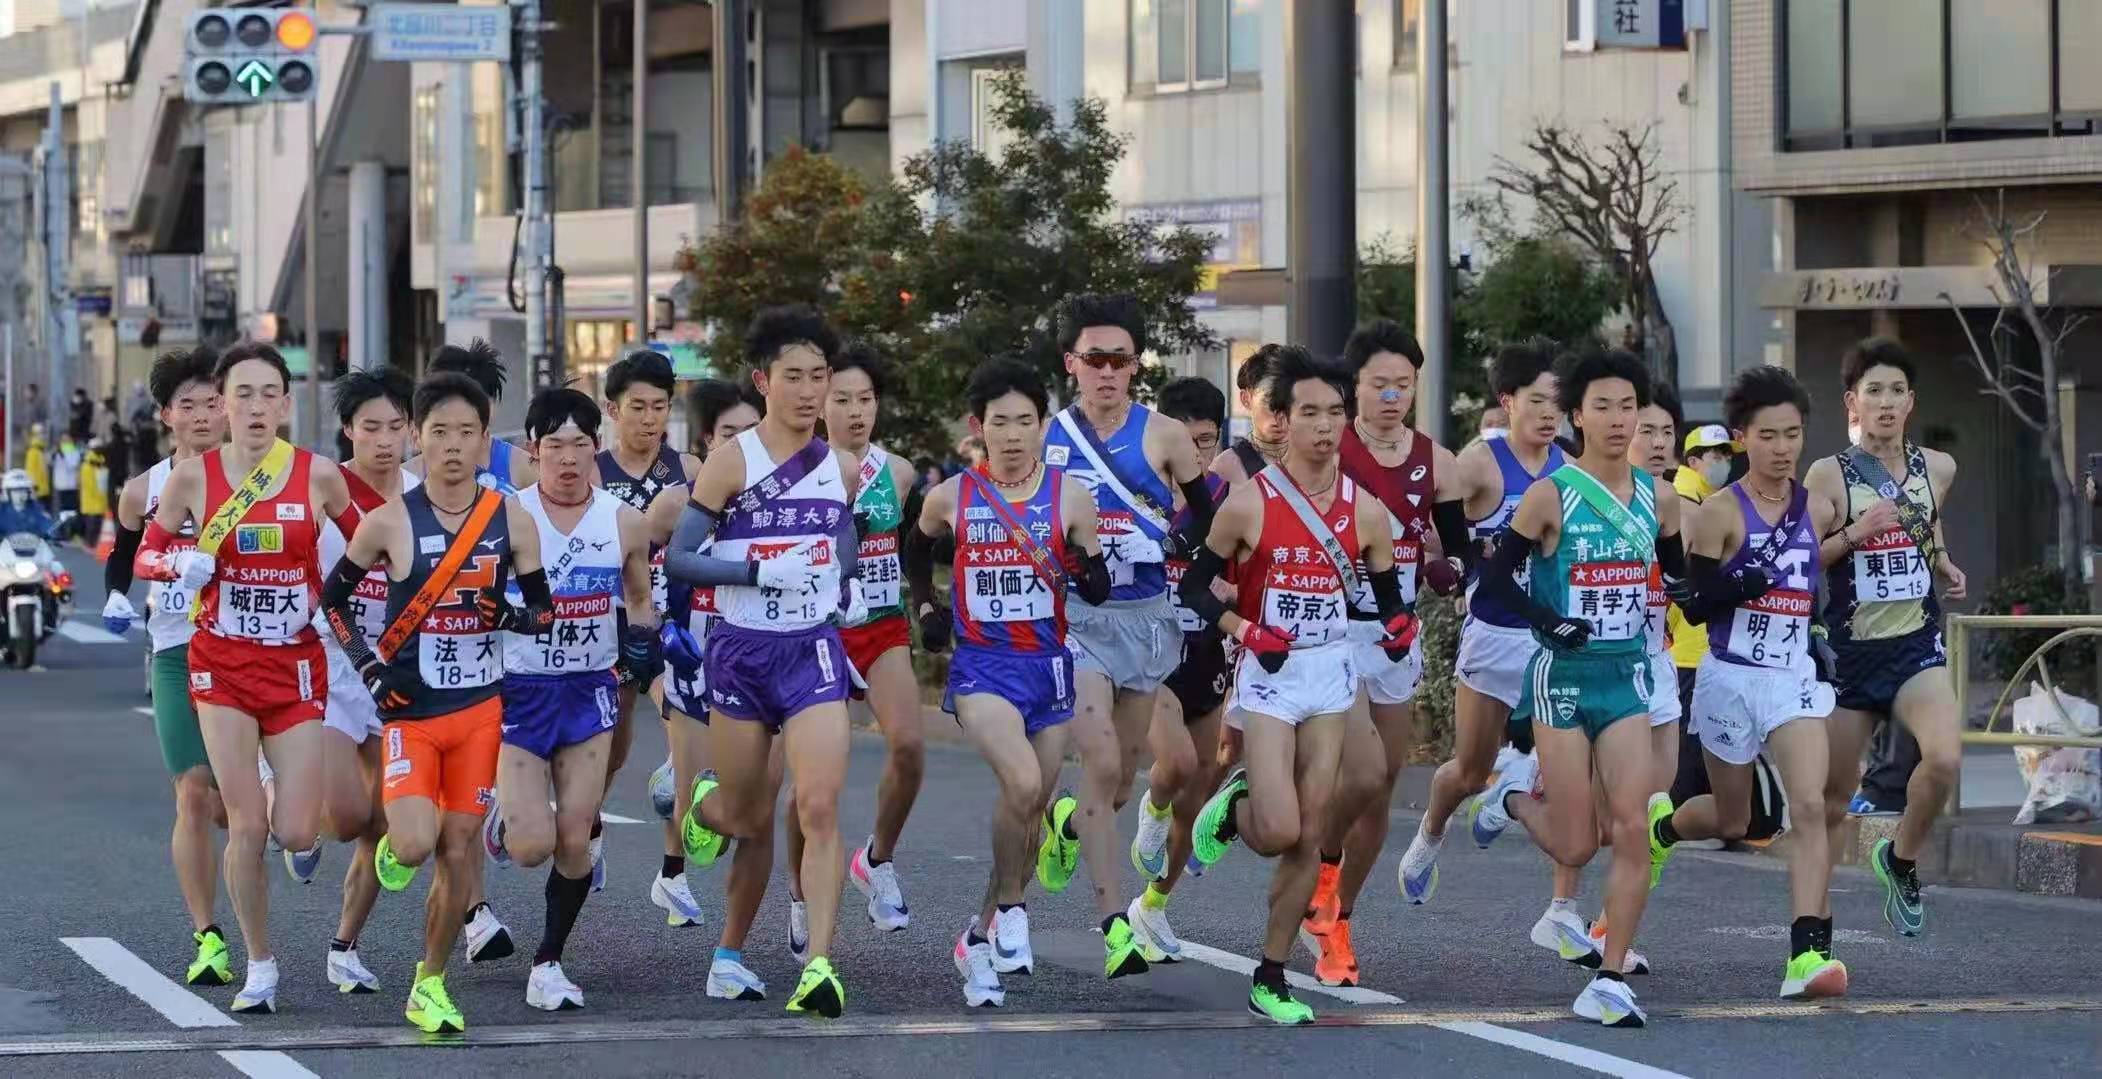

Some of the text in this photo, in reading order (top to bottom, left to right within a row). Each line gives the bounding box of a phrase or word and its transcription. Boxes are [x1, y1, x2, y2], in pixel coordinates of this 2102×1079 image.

[1616, 0, 1640, 33] 社
[207, 468, 272, 540] 城西大学
[966, 521, 1051, 544] 創価学
[985, 549, 1026, 562] SAPP
[1392, 546, 1417, 559] ORO
[1571, 537, 1638, 562] 青山学
[1591, 567, 1646, 582] SAPPORO
[1864, 551, 1925, 578] 東国大
[240, 567, 304, 583] SAPPORO
[975, 569, 1046, 597] 創価大
[1876, 579, 1923, 599] 5-15
[230, 585, 300, 615] 城西大
[553, 597, 608, 616] APPORO
[989, 600, 1034, 619] 9-1
[1278, 593, 1340, 621] 帝京大
[1580, 587, 1641, 616] 青学大
[766, 601, 816, 620] 8-15
[237, 615, 288, 635] 13-1
[1594, 618, 1630, 637] 1-1
[541, 648, 591, 668] 16-1
[1752, 642, 1791, 666] 6-1
